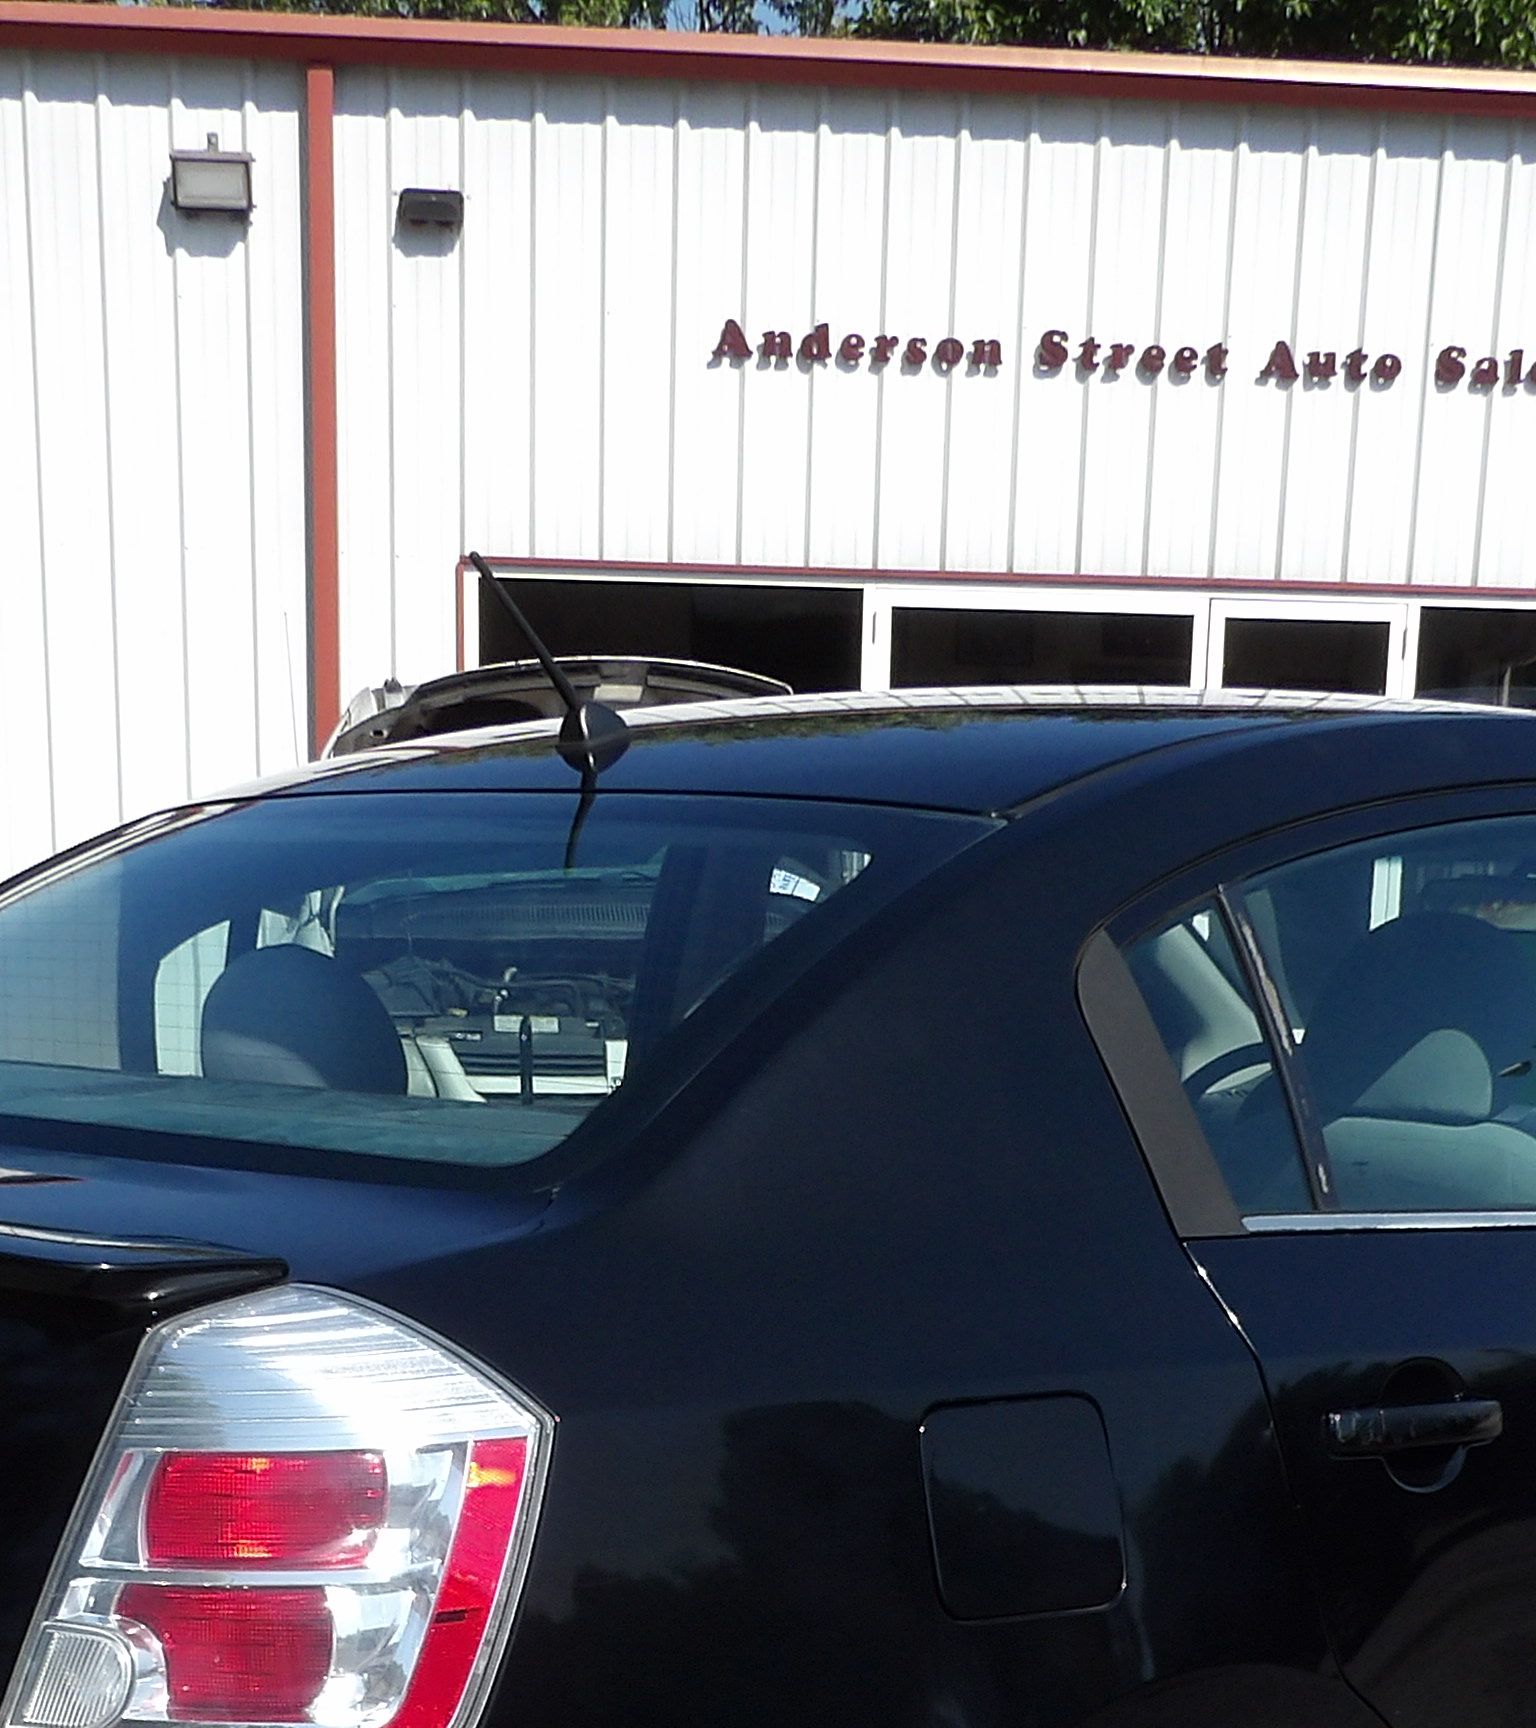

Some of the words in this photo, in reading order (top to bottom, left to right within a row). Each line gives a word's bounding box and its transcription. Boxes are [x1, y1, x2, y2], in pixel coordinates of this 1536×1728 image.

[710, 318, 1003, 368] Anderson
[1038, 329, 1228, 376] Street
[1258, 340, 1403, 384] Auto
